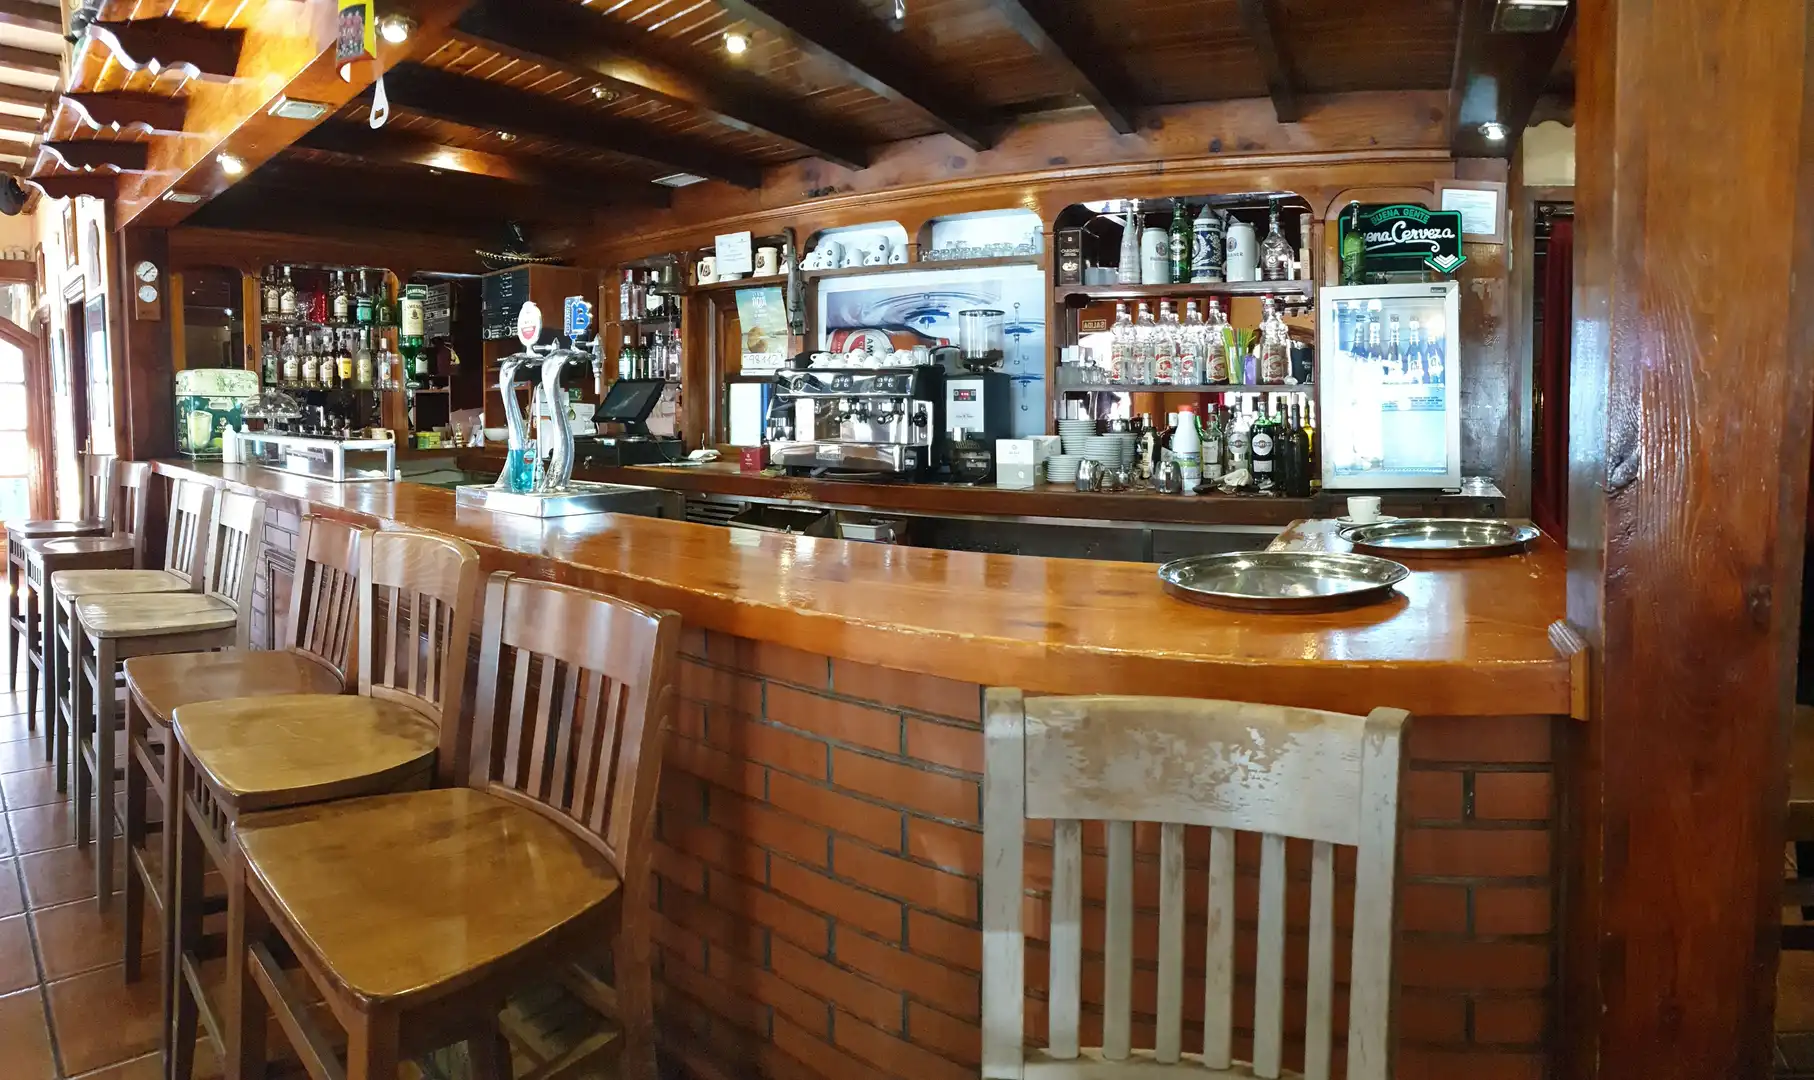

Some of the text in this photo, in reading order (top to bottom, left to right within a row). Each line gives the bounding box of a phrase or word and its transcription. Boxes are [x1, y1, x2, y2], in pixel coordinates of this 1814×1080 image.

[1370, 208, 1431, 225] BUENA GENTE
[1363, 220, 1455, 243] ena Cerveza
